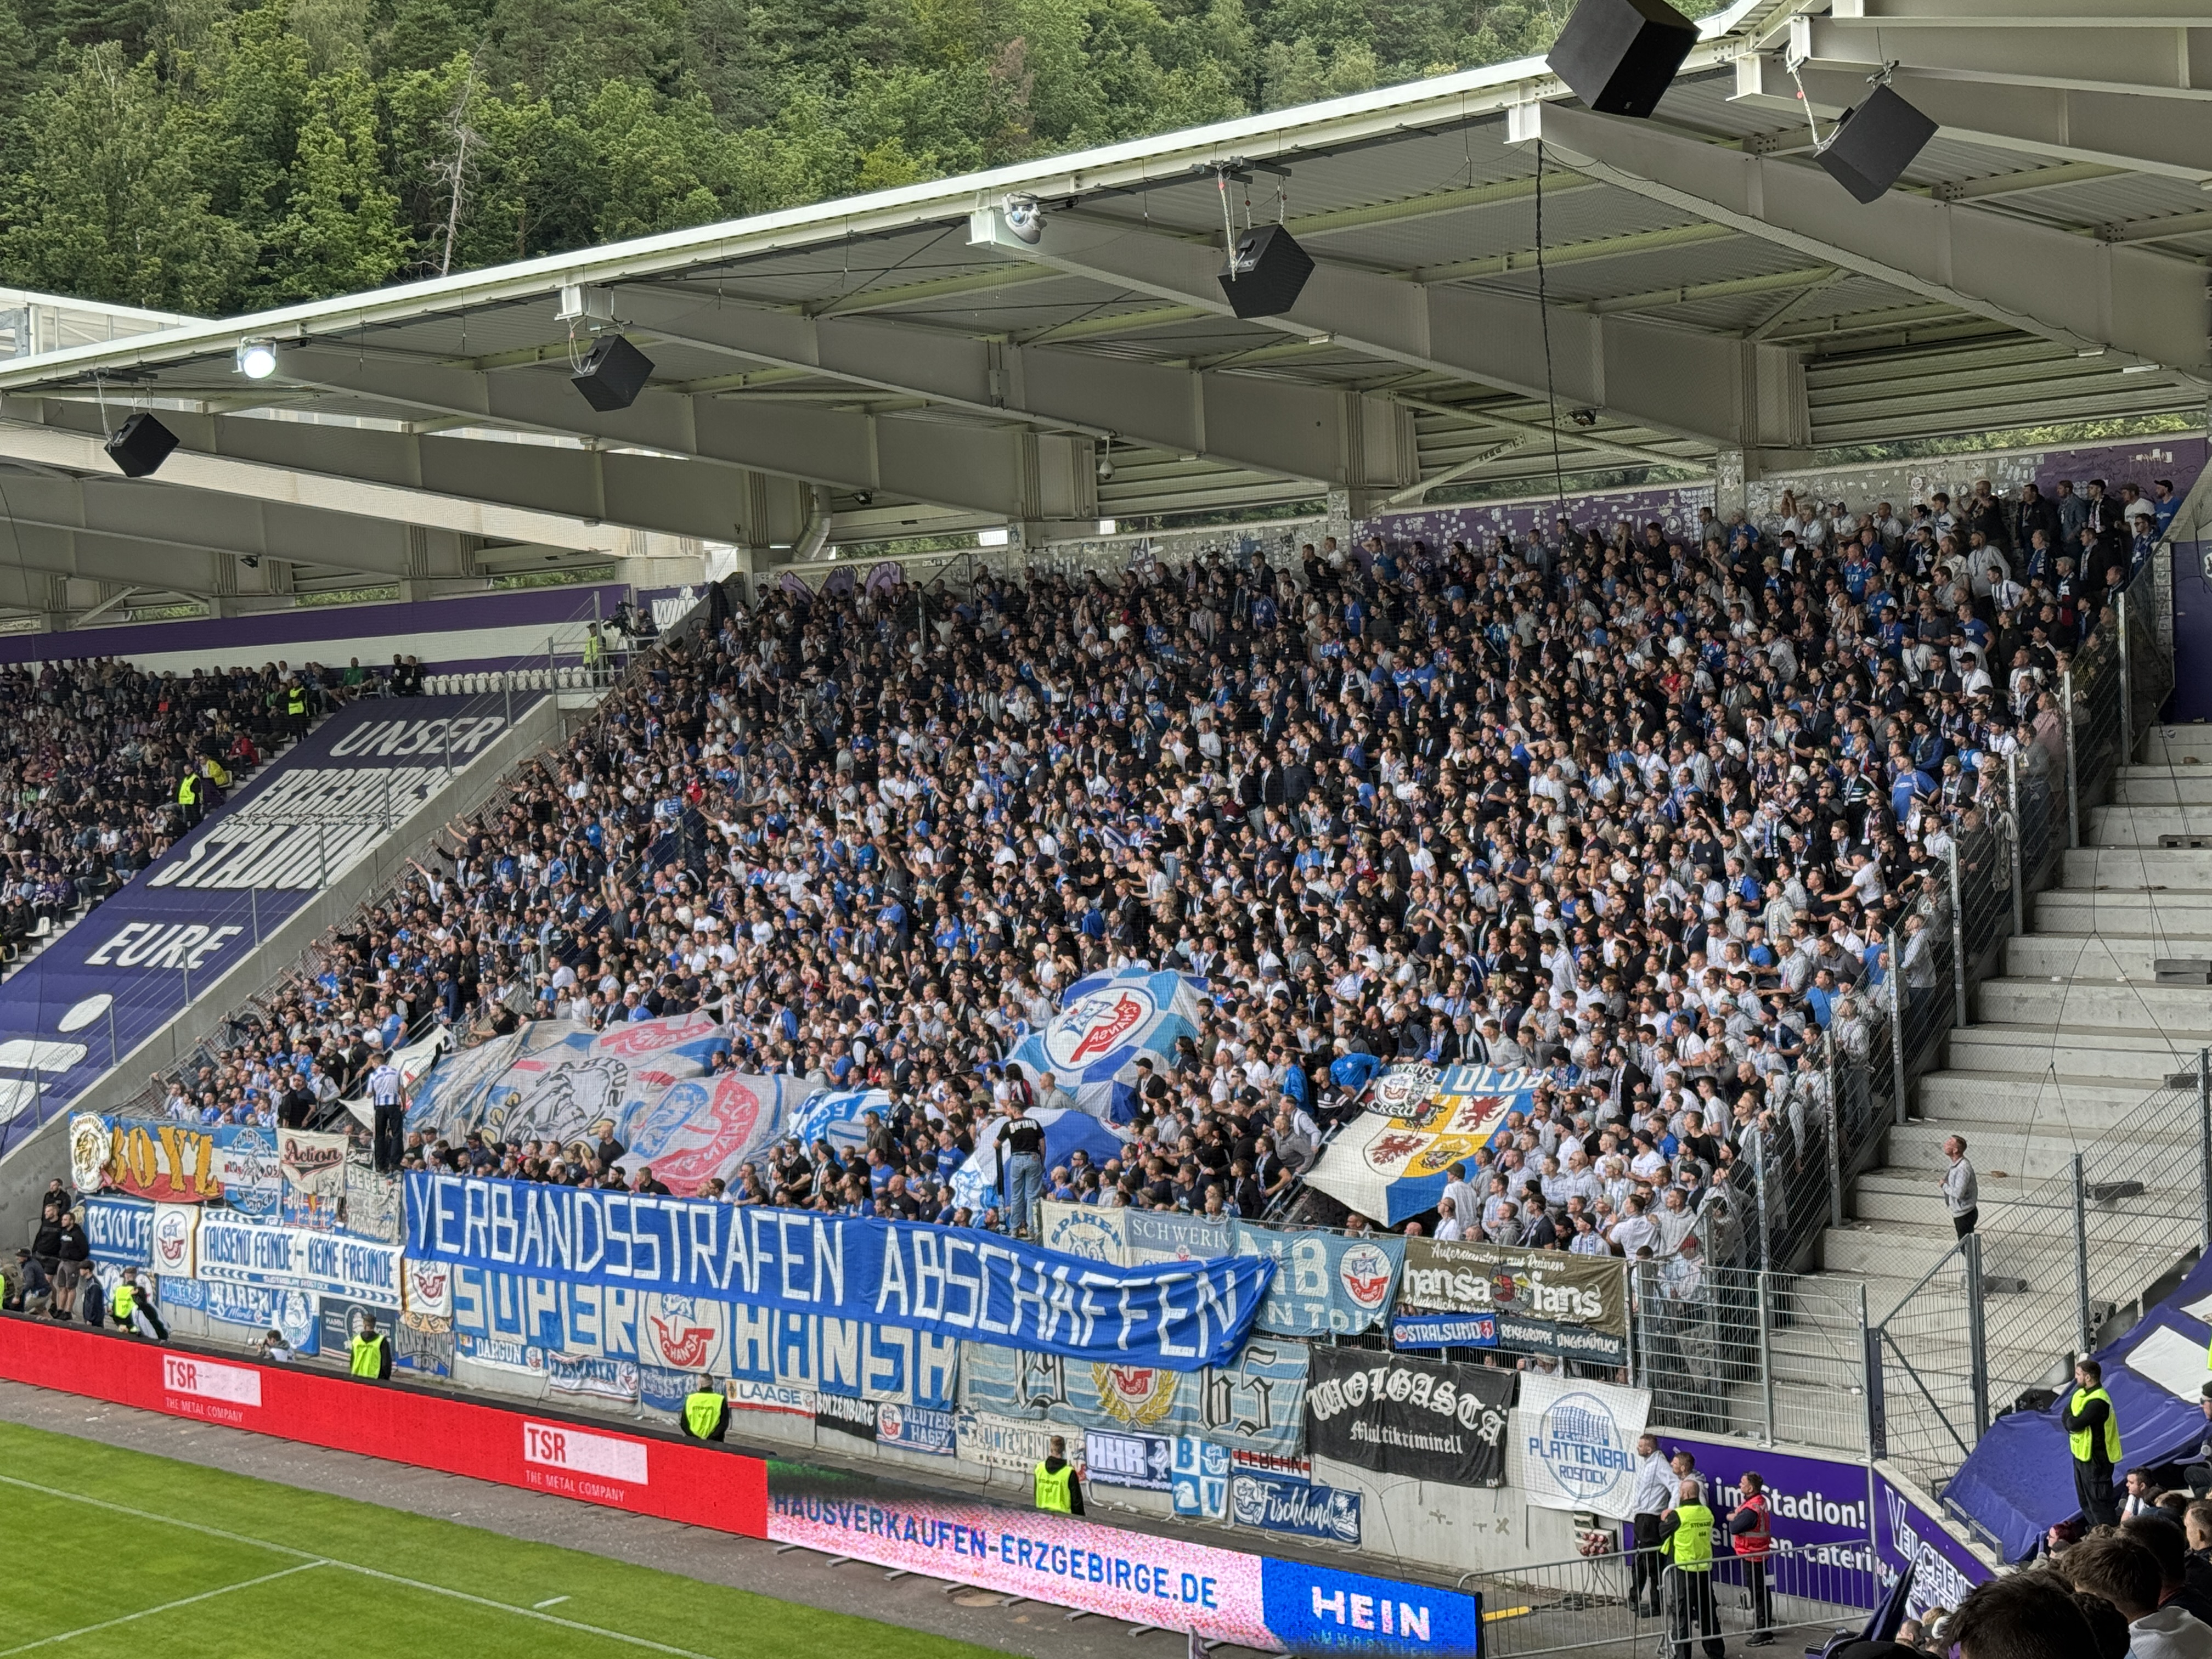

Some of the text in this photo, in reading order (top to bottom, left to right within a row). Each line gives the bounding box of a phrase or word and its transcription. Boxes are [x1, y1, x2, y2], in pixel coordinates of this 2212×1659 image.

[330, 717, 505, 757] UNSER
[146, 823, 391, 889] STADION
[86, 923, 244, 969] EURE
[284, 1138, 344, 1162] Action
[87, 1206, 154, 1250] REVOLTE
[410, 1173, 843, 1306] VERBANDSSTRAFEN
[1133, 1219, 1232, 1250] SCHWERIN
[205, 1226, 253, 1267] TAUSEND
[255, 1231, 294, 1271] FEINDE
[308, 1237, 339, 1278] KEINE
[342, 1243, 396, 1289] FREUNDE
[1403, 1260, 1602, 1317] hansa fans
[454, 1264, 636, 1358] SUPER
[670, 1334, 699, 1361] HANSA
[1408, 1321, 1481, 1342] STRALSUND
[1500, 1323, 1620, 1354] REISEGRUPPE UNGEMÜTLICH
[476, 1338, 522, 1364] DARGUN
[166, 1359, 198, 1391] TSR
[166, 1397, 243, 1423] THE METAL COMPANY
[740, 1383, 802, 1406] LAAGE
[816, 1391, 875, 1426] BOIZENBURG
[527, 1427, 566, 1464] TSR
[1350, 1420, 1464, 1454] Multikriminell
[1529, 1437, 1636, 1473] PLATTENBAU
[526, 1470, 625, 1503] THE METAL COMPANY
[1559, 1464, 1608, 1486] ROSTOCK
[1760, 1485, 1866, 1530] Stadion!
[774, 1491, 1218, 1610] HAUSVERKAUFEN-ERZGEBIRGE.DE
[1311, 1585, 1431, 1643] HEIN
